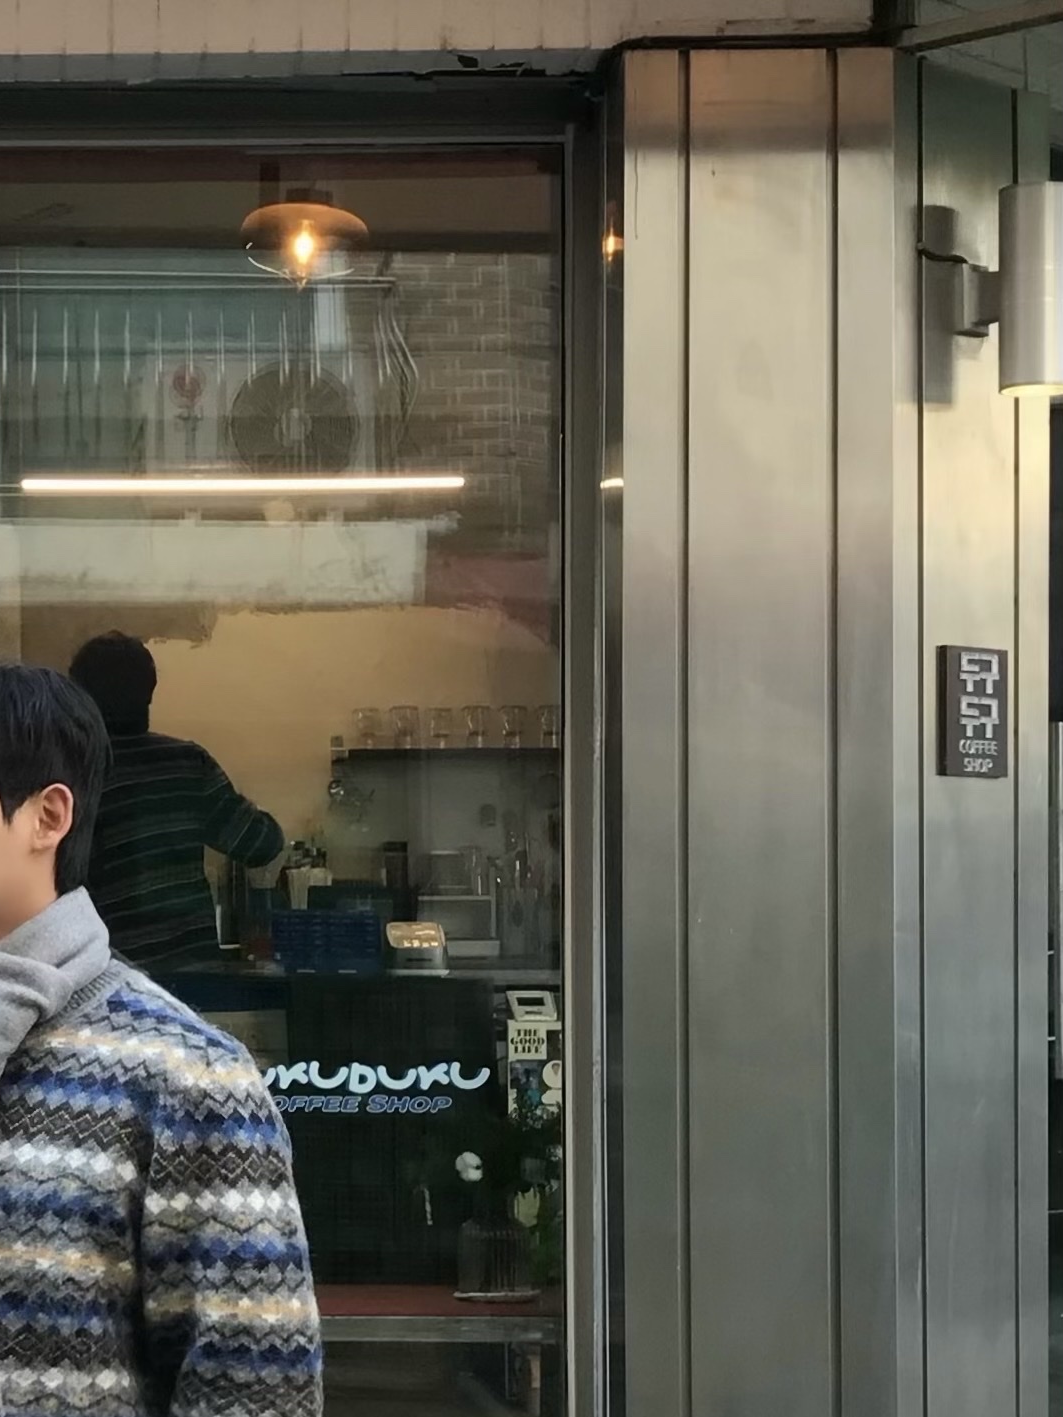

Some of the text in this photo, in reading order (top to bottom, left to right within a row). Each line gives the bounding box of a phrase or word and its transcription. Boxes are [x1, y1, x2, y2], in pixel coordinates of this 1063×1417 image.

[959, 739, 998, 756] COFFEE
[963, 757, 994, 773] SHOP
[510, 1037, 545, 1045] GOOD
[515, 1029, 540, 1037] THE
[366, 1095, 452, 1113] SHOP
